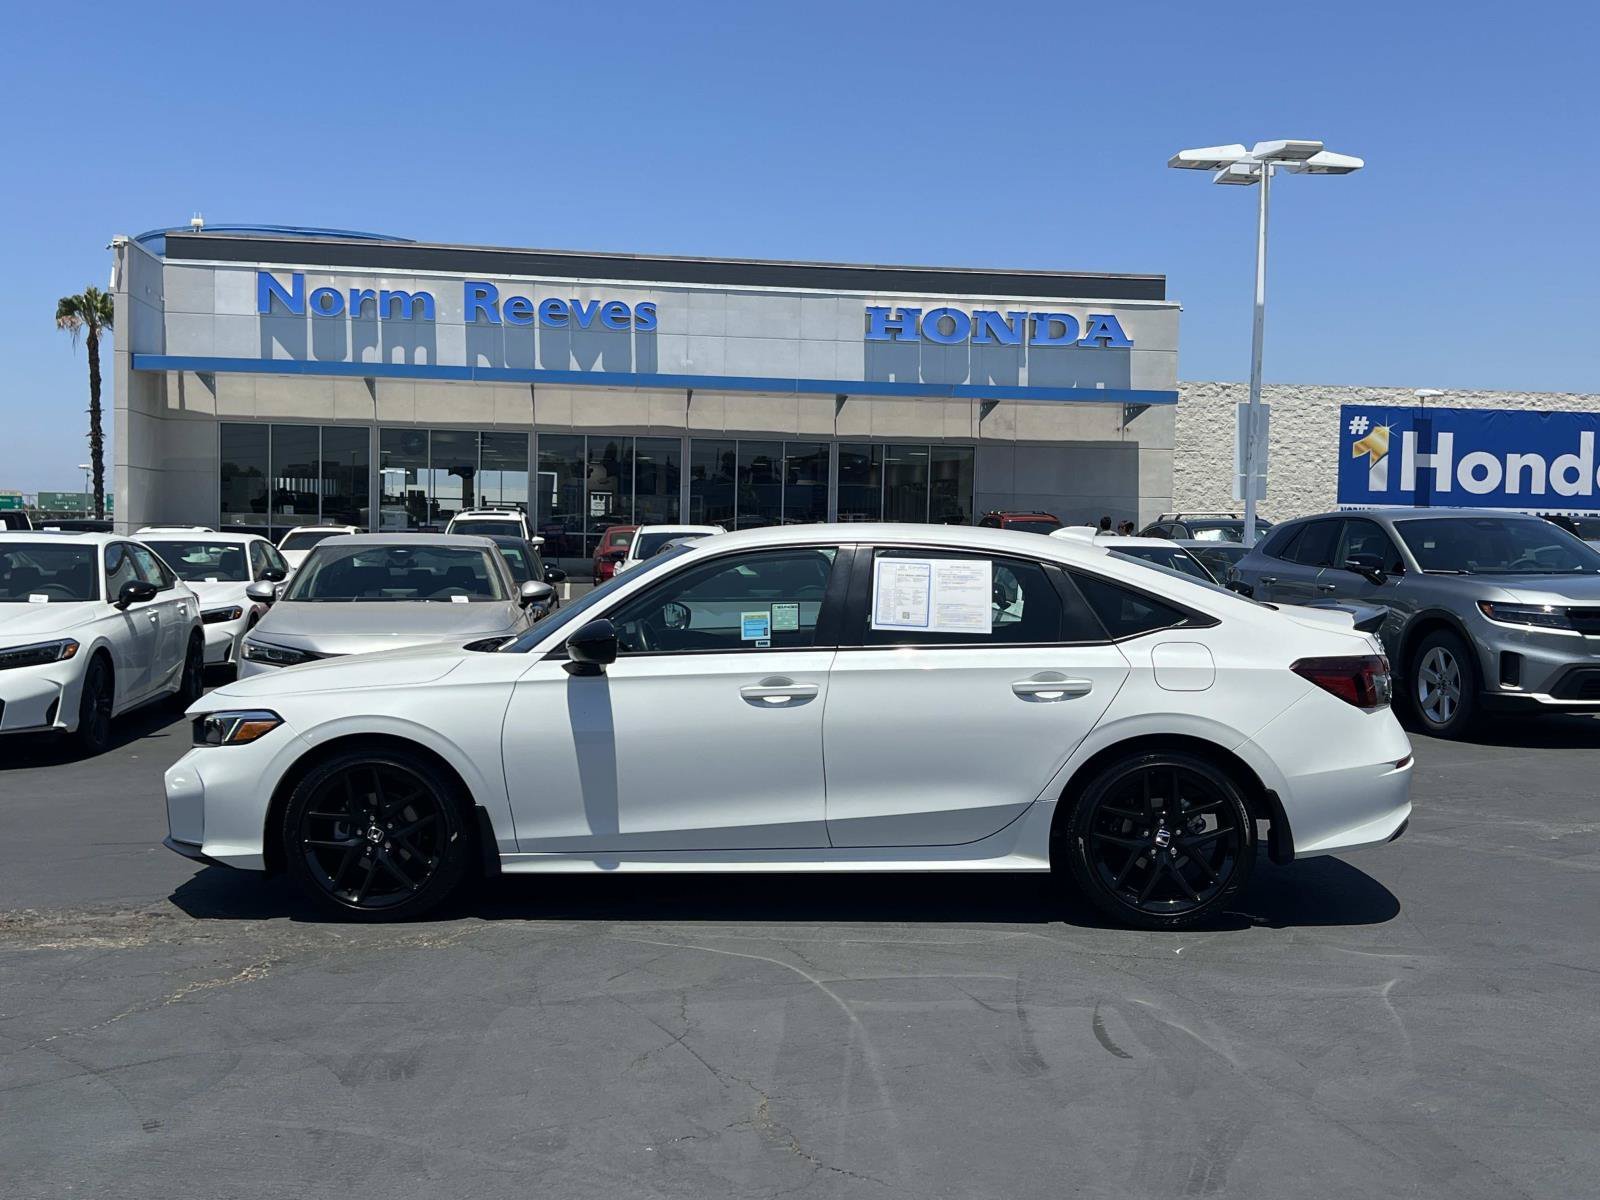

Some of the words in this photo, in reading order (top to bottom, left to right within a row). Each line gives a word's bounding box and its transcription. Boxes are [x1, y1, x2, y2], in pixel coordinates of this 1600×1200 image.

[256, 271, 436, 321] Norm
[463, 281, 657, 332] Reeves
[865, 306, 1134, 348] HONDA
[1400, 430, 1600, 497] Hond
